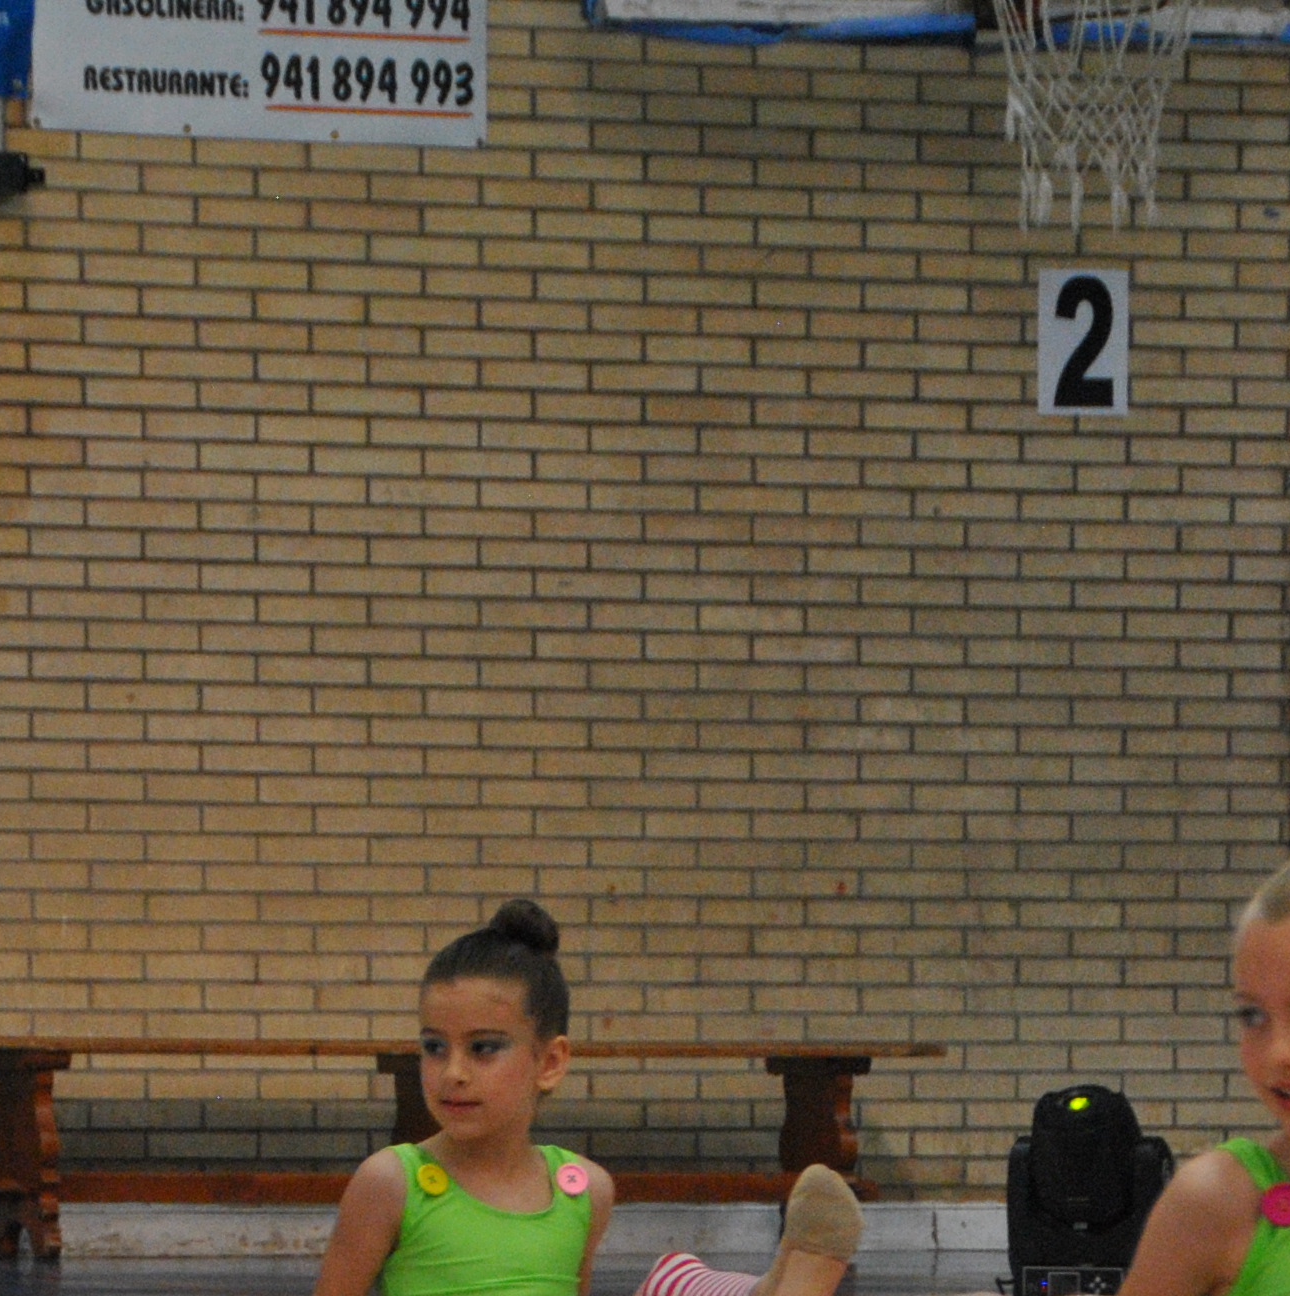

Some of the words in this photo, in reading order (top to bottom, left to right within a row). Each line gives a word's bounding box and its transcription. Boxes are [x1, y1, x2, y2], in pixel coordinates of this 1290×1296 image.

[327, 0, 393, 29] 894
[404, 0, 472, 32] 994
[83, 65, 250, 98] RESTAURANTE:
[260, 52, 320, 102] 941
[332, 56, 398, 104] 894
[410, 59, 476, 107] 993
[1054, 275, 1114, 408] 2
